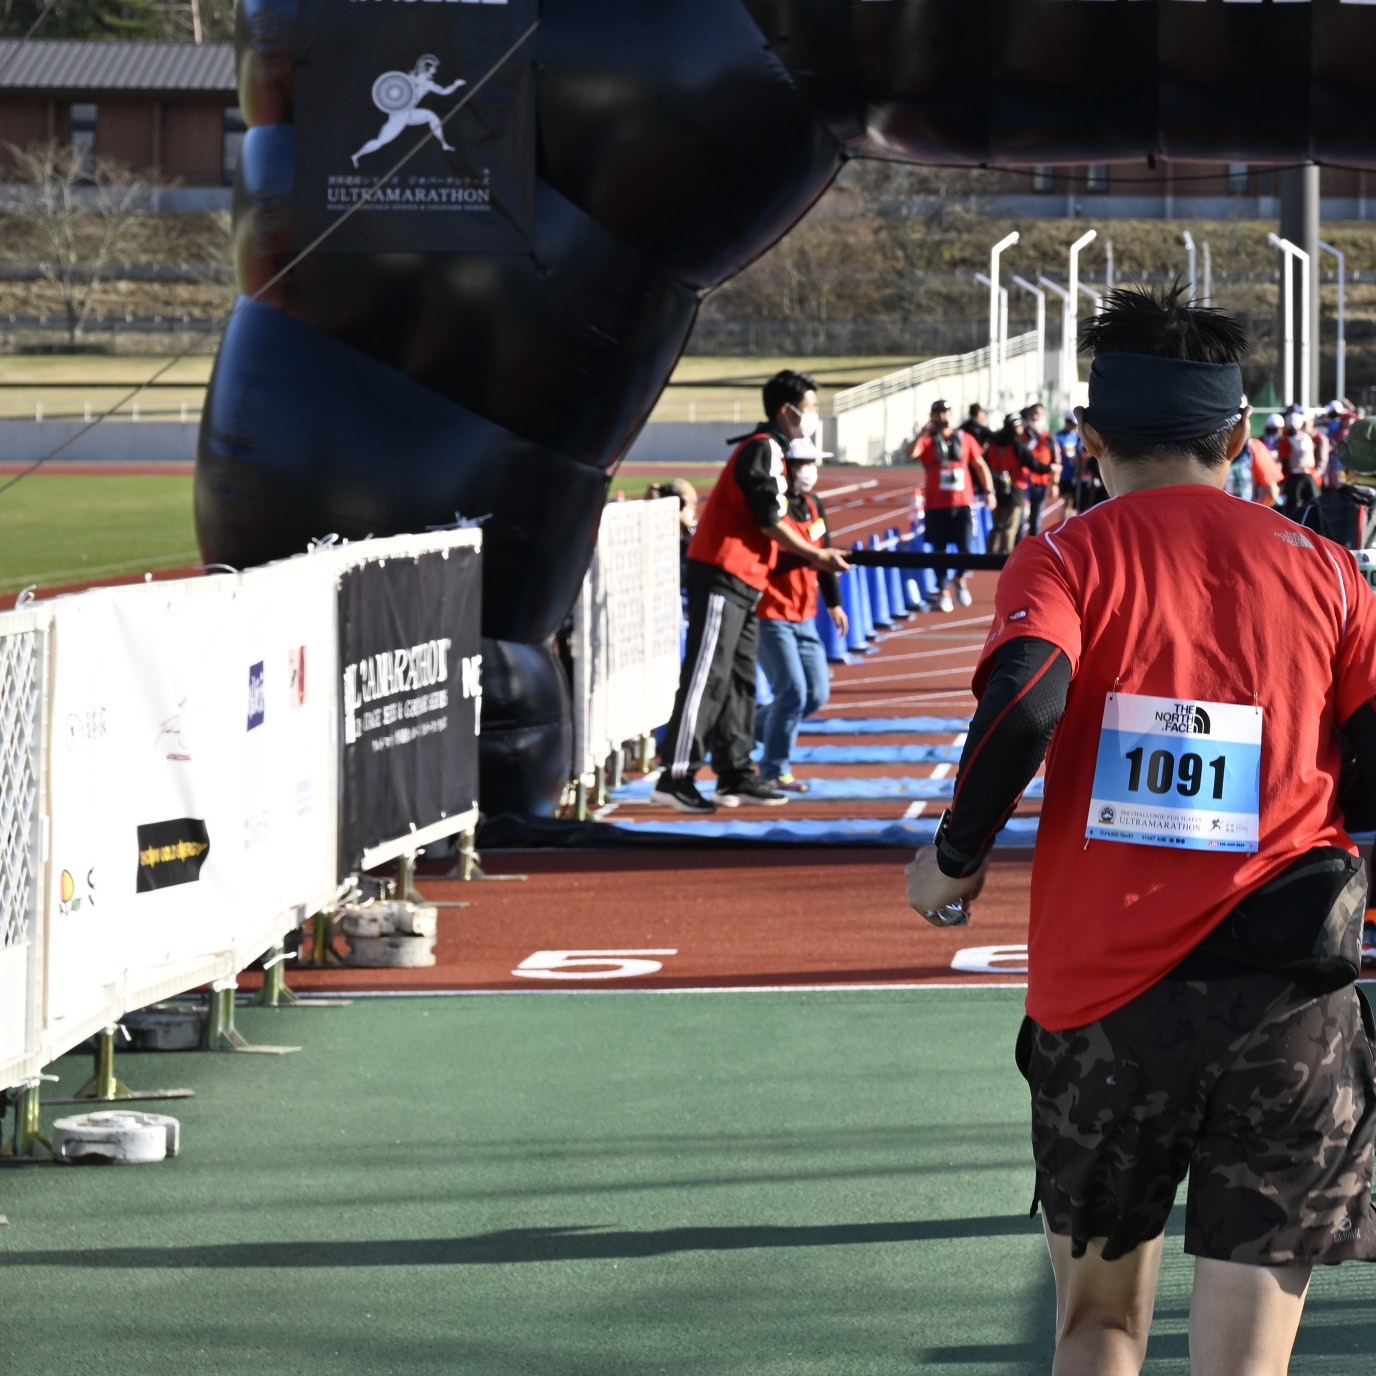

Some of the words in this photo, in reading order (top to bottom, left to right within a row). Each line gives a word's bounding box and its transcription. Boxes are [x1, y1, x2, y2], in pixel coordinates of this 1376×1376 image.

[327, 187, 490, 202] ULTRAMARATHON
[1173, 703, 1195, 715] THE
[1155, 711, 1194, 724] NORTH
[1165, 722, 1194, 734] FACE
[1126, 746, 1226, 800] 1091
[1119, 816, 1201, 832] ULTRAMARATHON
[511, 948, 678, 980] 5
